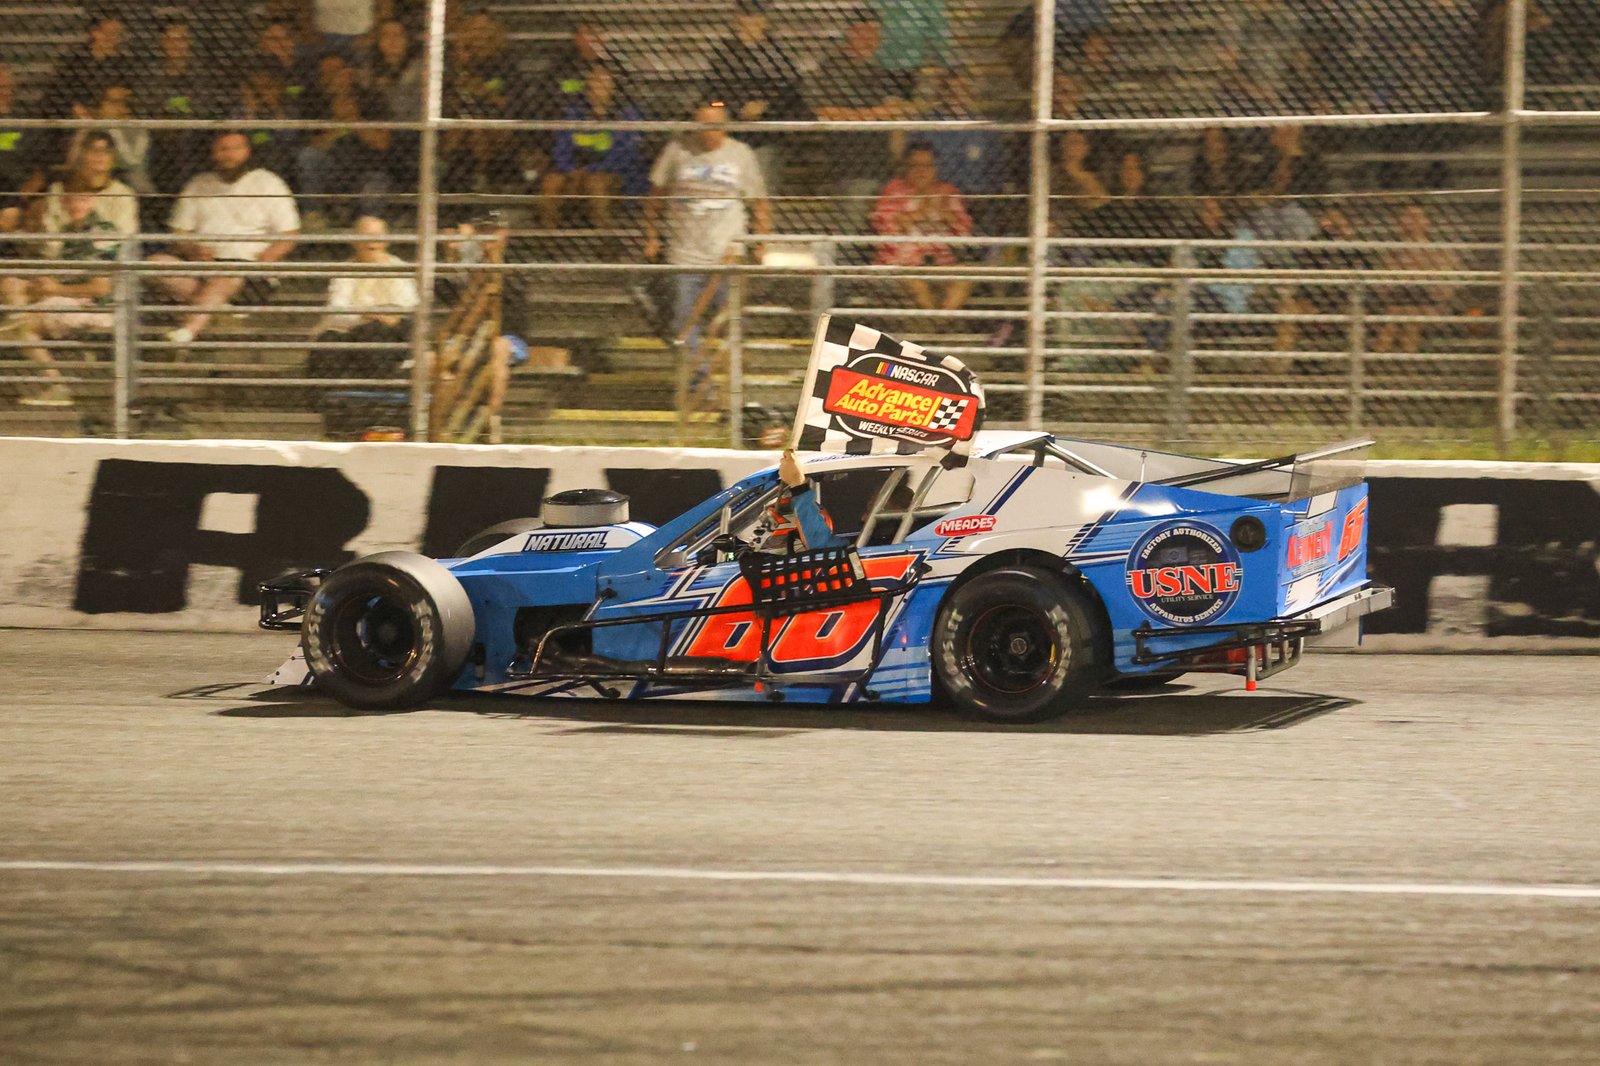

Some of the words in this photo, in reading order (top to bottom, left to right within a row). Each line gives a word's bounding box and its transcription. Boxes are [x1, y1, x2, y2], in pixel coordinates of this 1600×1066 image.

[890, 364, 940, 387] NASCAR
[848, 379, 932, 411] Advance
[834, 394, 878, 415] Auto
[878, 403, 925, 426] Parts
[858, 420, 895, 435] WEEKLY
[940, 516, 994, 532] MEADES
[524, 532, 608, 551] NATURAL
[1141, 530, 1171, 560] FACTORY
[1173, 528, 1223, 554] AUTHORIZED
[1127, 562, 1239, 599] USNE
[1149, 602, 1194, 623] APPARATUS
[1194, 598, 1224, 622] SERVICE
[1161, 596, 1185, 604] UTILITY
